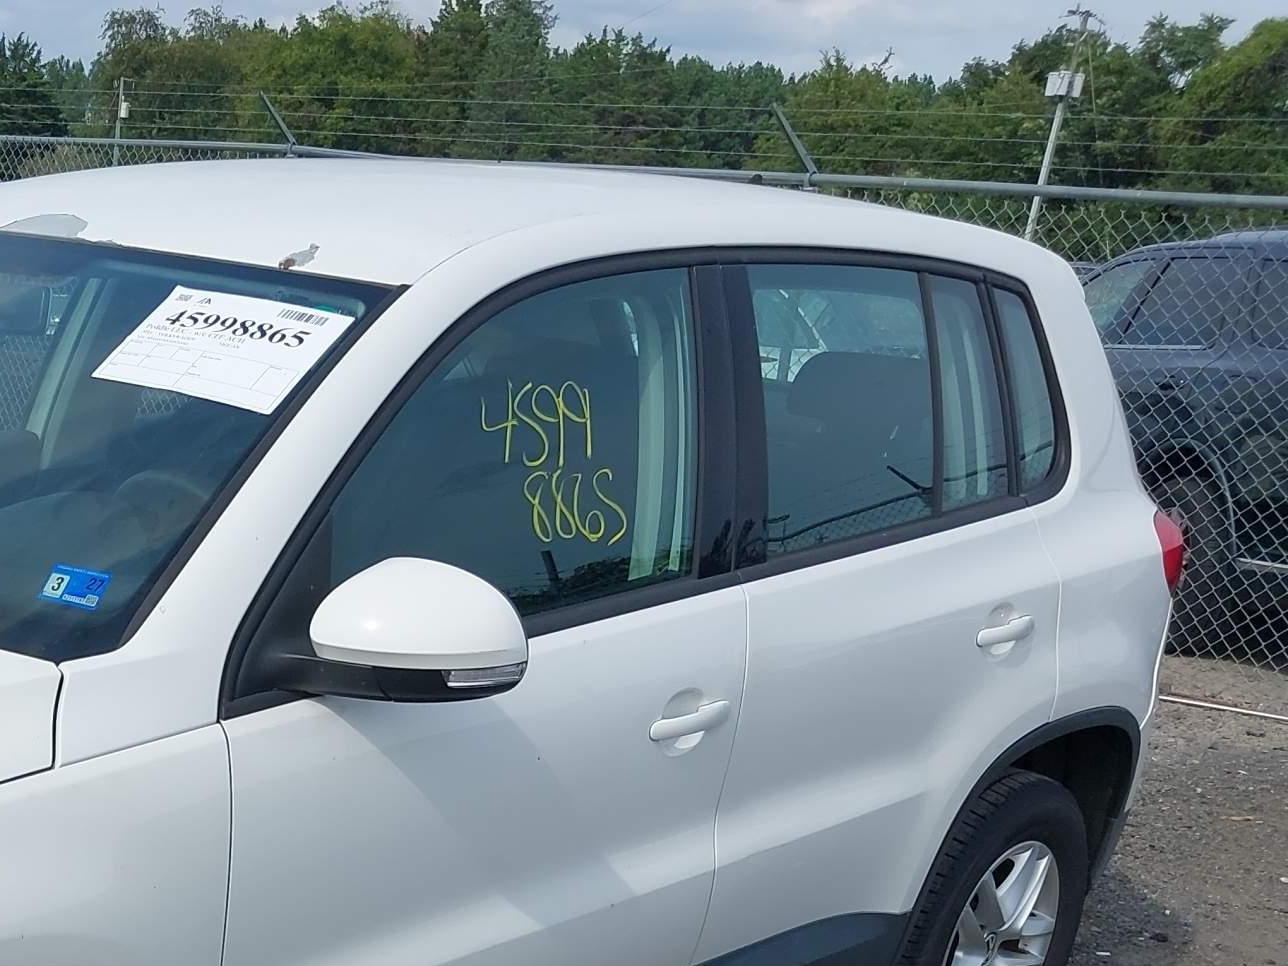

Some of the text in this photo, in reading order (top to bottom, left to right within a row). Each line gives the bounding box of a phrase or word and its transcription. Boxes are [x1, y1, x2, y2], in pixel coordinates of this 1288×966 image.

[165, 309, 313, 348] 45998865
[480, 376, 593, 468] 4599
[523, 468, 628, 546] 8865
[51, 576, 65, 592] 3
